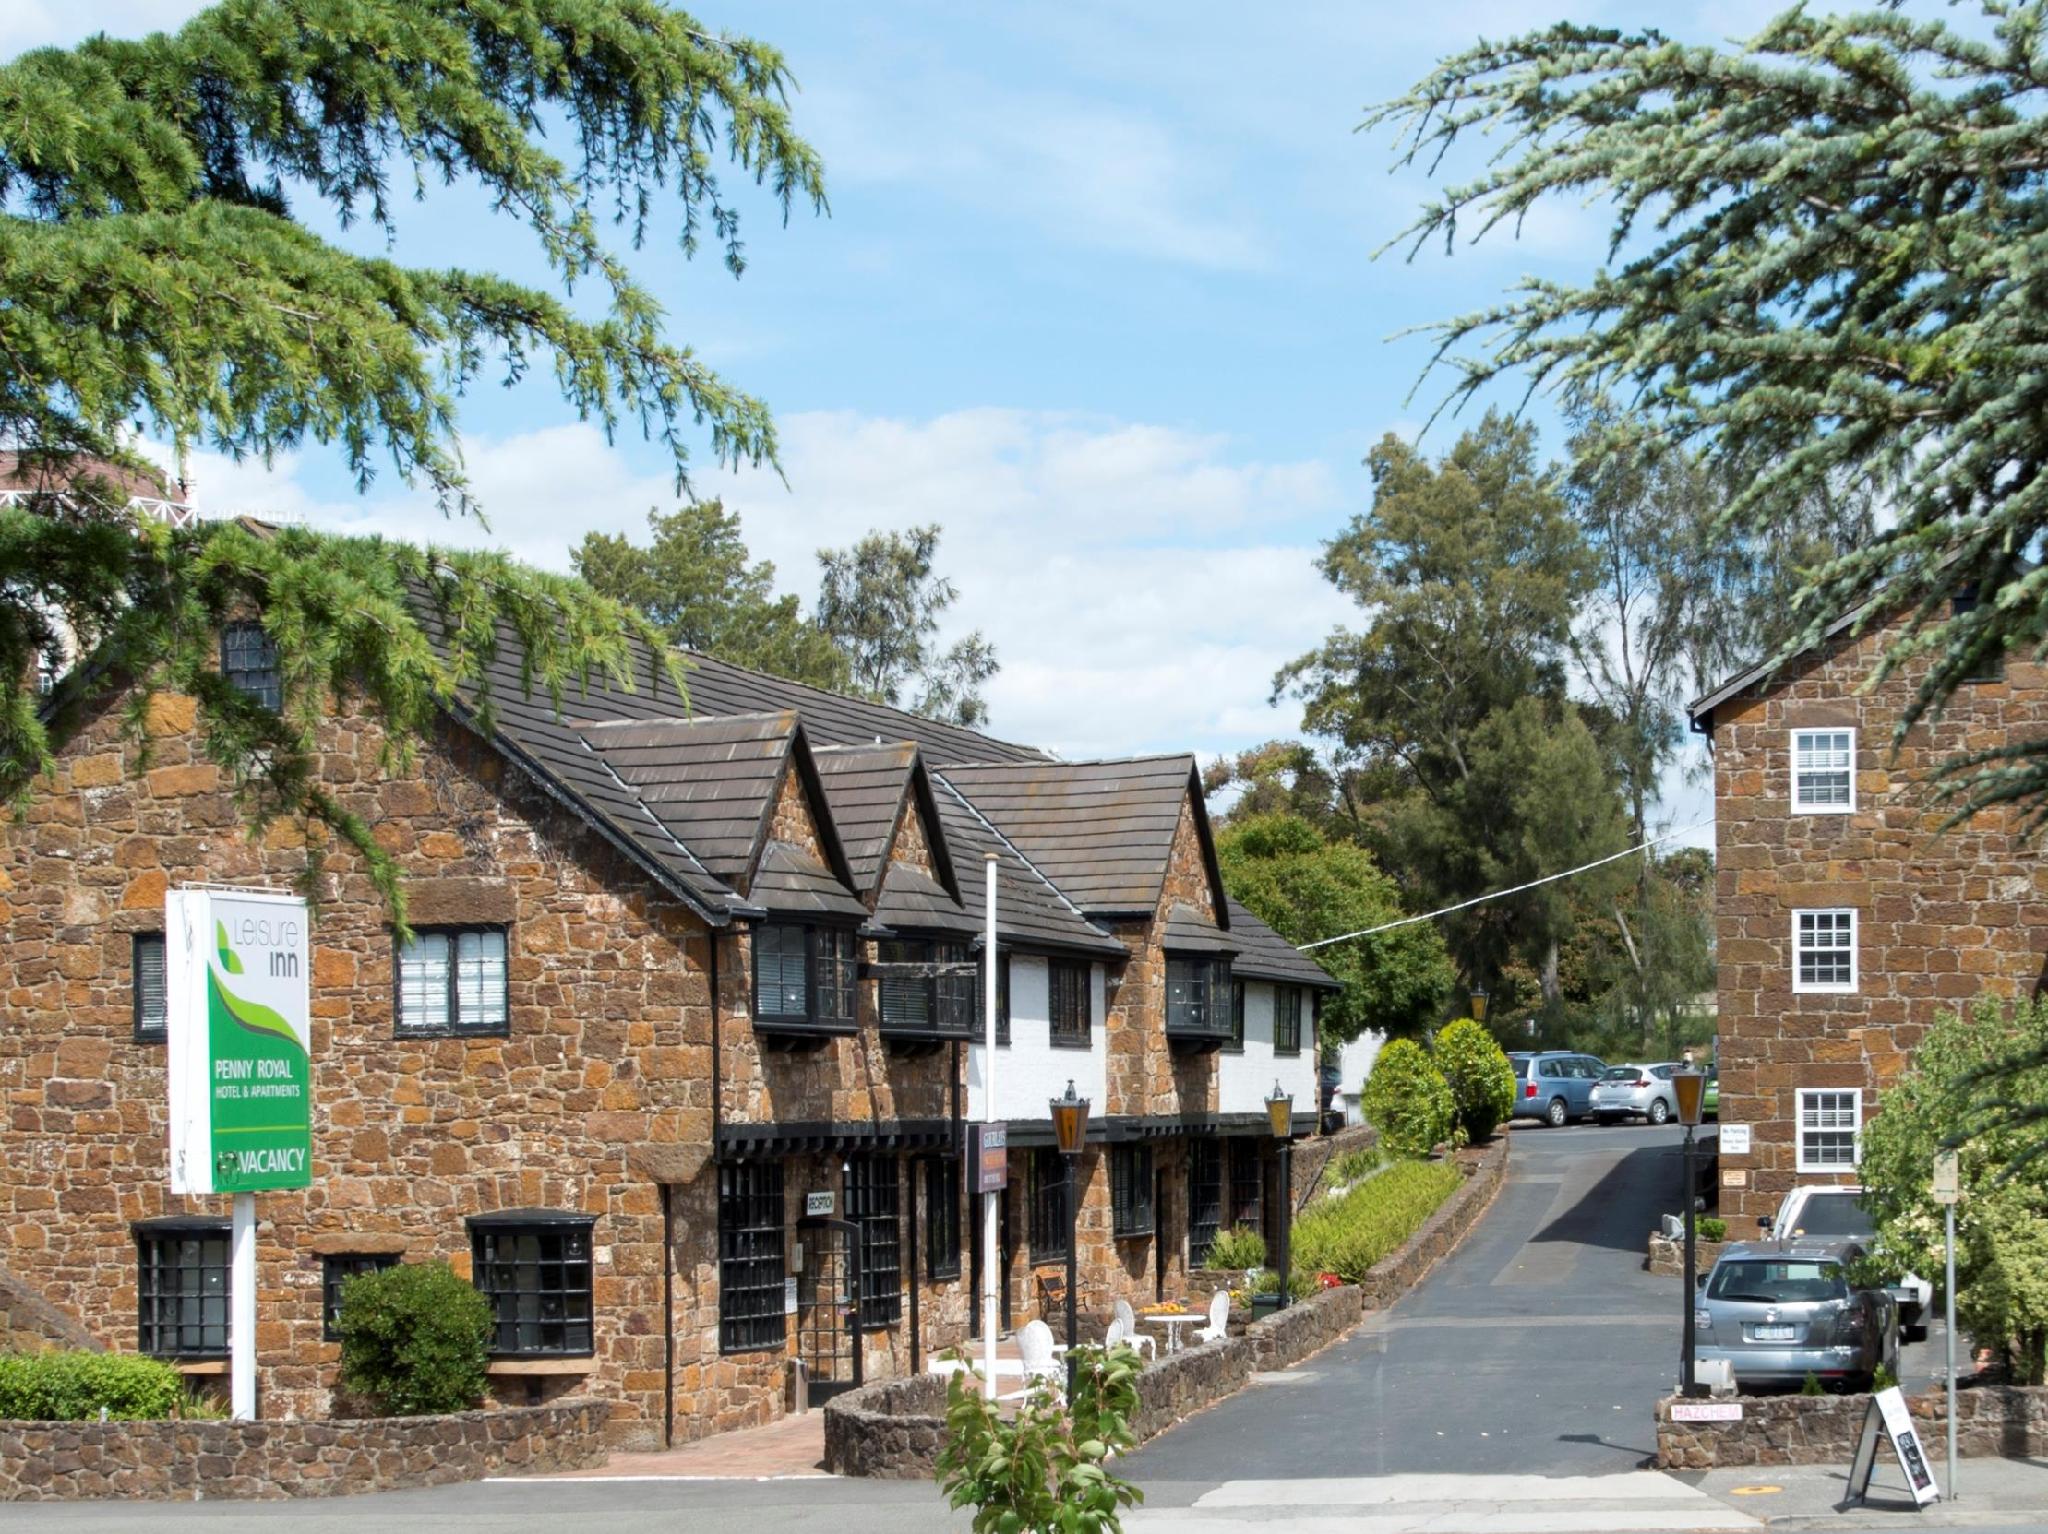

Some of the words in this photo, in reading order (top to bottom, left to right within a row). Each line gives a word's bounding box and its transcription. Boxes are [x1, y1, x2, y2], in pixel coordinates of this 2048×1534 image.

[234, 918, 298, 947] Leisure
[215, 1059, 253, 1079] PENNY
[257, 1059, 293, 1078] ROYAL
[216, 1085, 241, 1099] HOTEL
[243, 1085, 249, 1097] &
[251, 1084, 300, 1098] APARTMENTS
[239, 1148, 305, 1173] VACANCY
[1674, 1406, 1740, 1420] HAZCHEM
